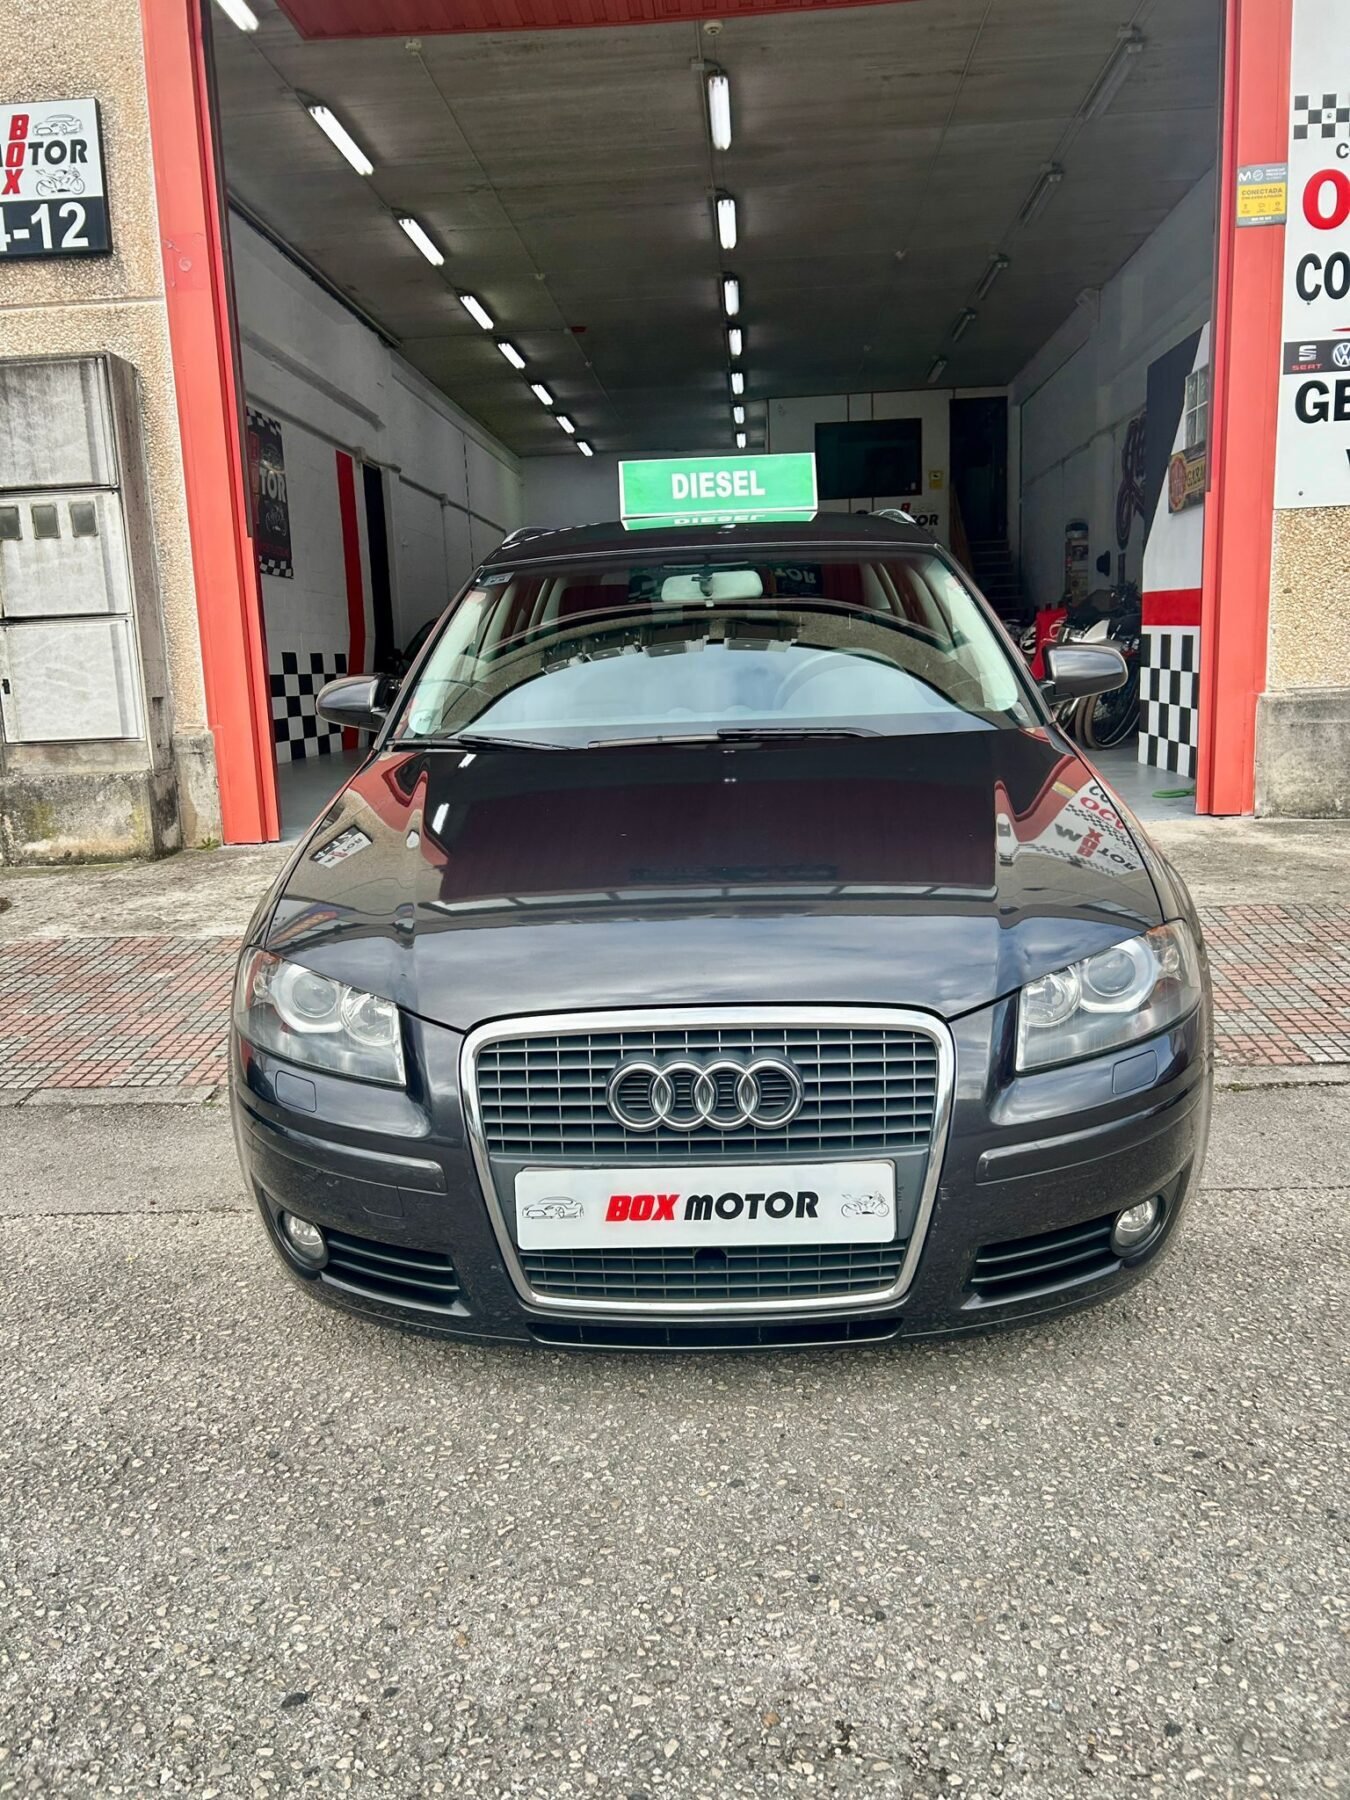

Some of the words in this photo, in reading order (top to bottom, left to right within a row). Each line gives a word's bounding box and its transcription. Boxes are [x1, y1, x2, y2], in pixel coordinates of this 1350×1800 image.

[1241, 187, 1283, 196] CONECTADA
[1295, 251, 1350, 301] CO
[670, 469, 766, 500] DIESEL
[605, 1193, 680, 1222] BOX
[683, 1191, 819, 1221] MOTOR
